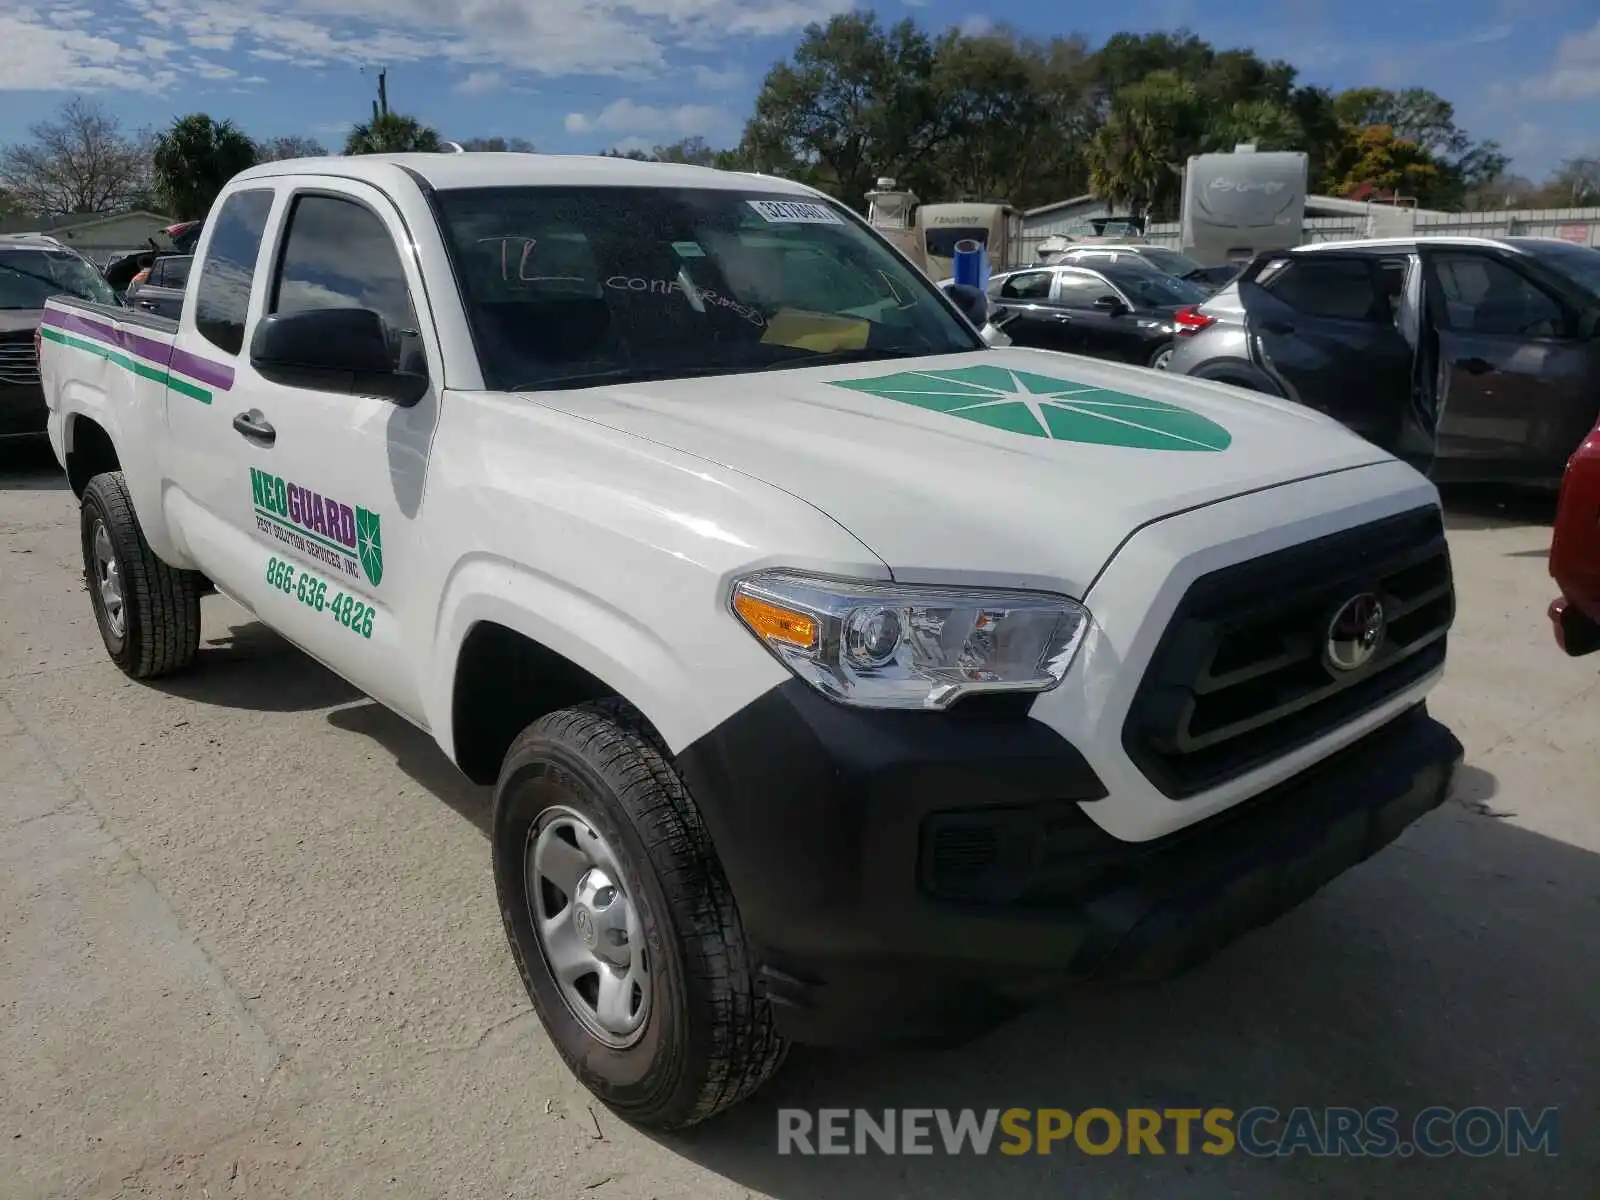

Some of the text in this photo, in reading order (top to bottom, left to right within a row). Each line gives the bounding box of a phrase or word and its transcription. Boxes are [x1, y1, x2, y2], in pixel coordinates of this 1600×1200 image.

[249, 467, 356, 549] NEOGUARD
[256, 515, 361, 581] PEST SOLUTION SERVICES, INC.
[266, 556, 376, 638] 866-636-4826
